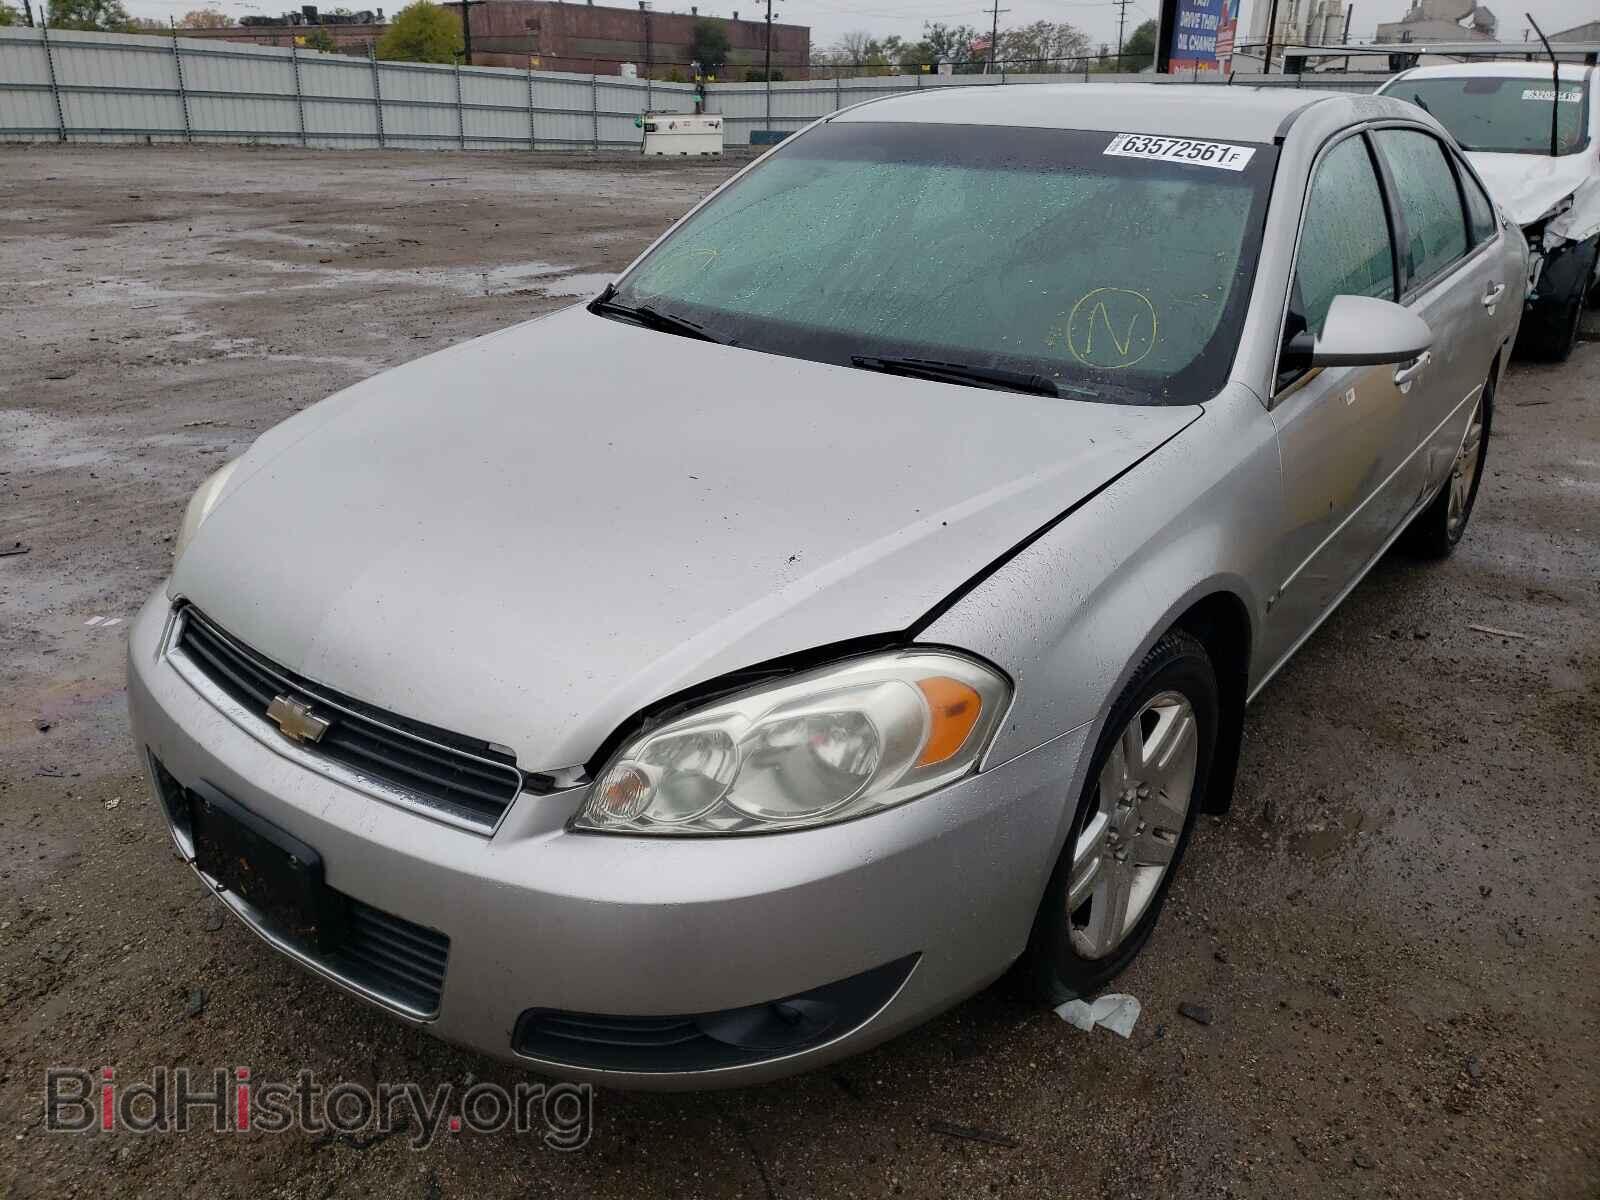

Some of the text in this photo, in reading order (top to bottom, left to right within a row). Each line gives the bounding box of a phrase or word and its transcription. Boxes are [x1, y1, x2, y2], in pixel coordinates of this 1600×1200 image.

[1180, 11, 1220, 31] DRIVE THRU
[1178, 33, 1217, 53] OIL CHANGE
[1087, 301, 1138, 355] N
